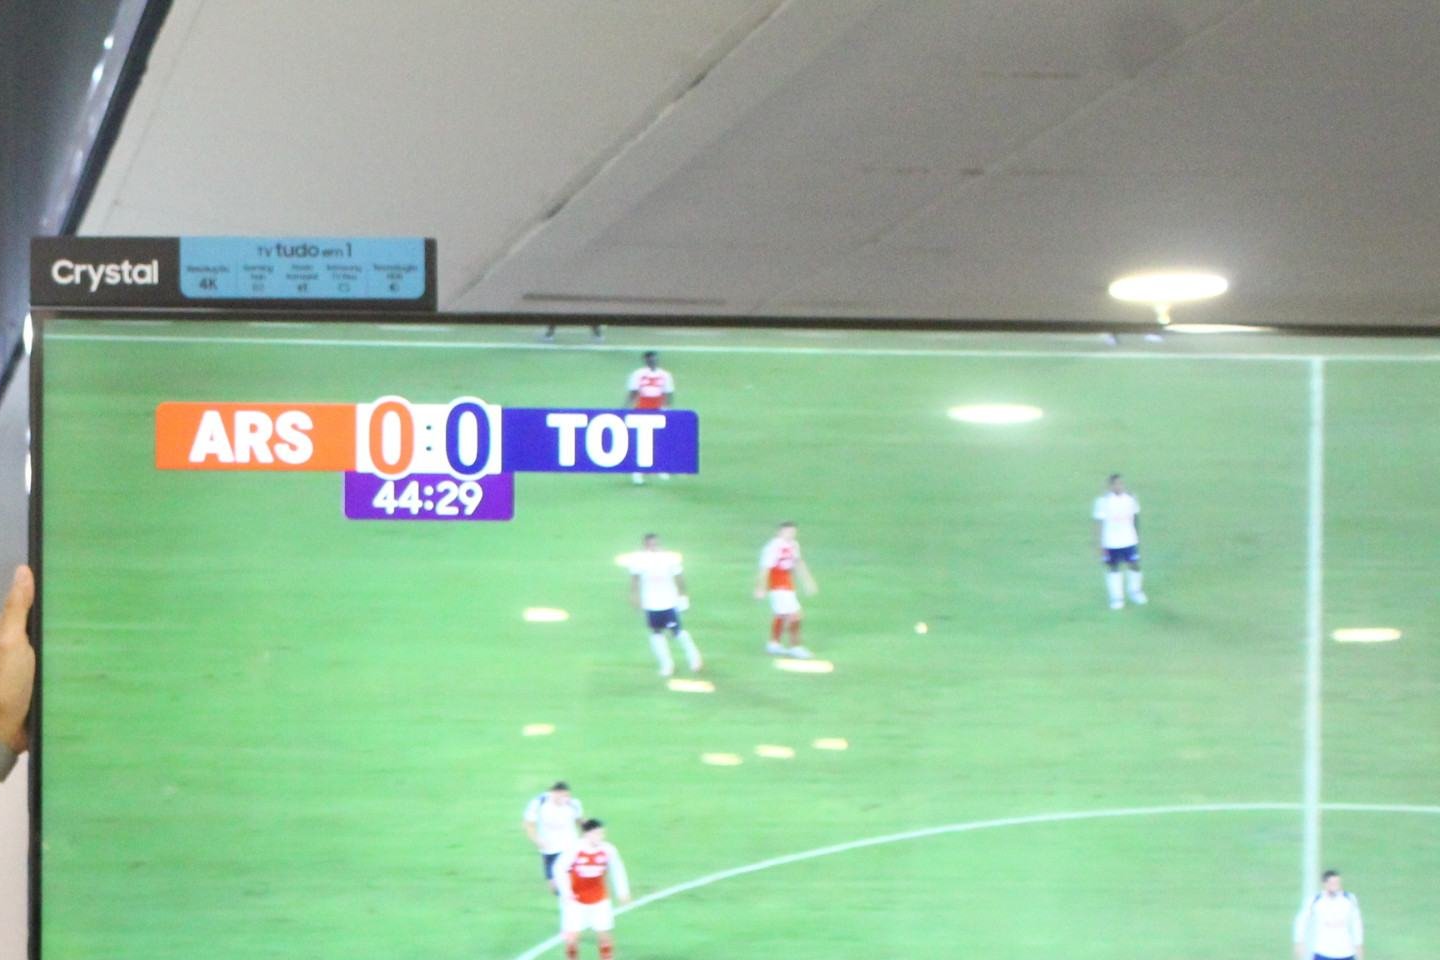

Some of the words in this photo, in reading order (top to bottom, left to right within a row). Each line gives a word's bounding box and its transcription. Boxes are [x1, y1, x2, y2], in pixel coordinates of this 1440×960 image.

[275, 243, 320, 258] tudo
[51, 257, 160, 292] Crystal
[188, 410, 314, 464] ARS
[546, 412, 666, 468] TOT
[372, 480, 484, 516] 44:29
